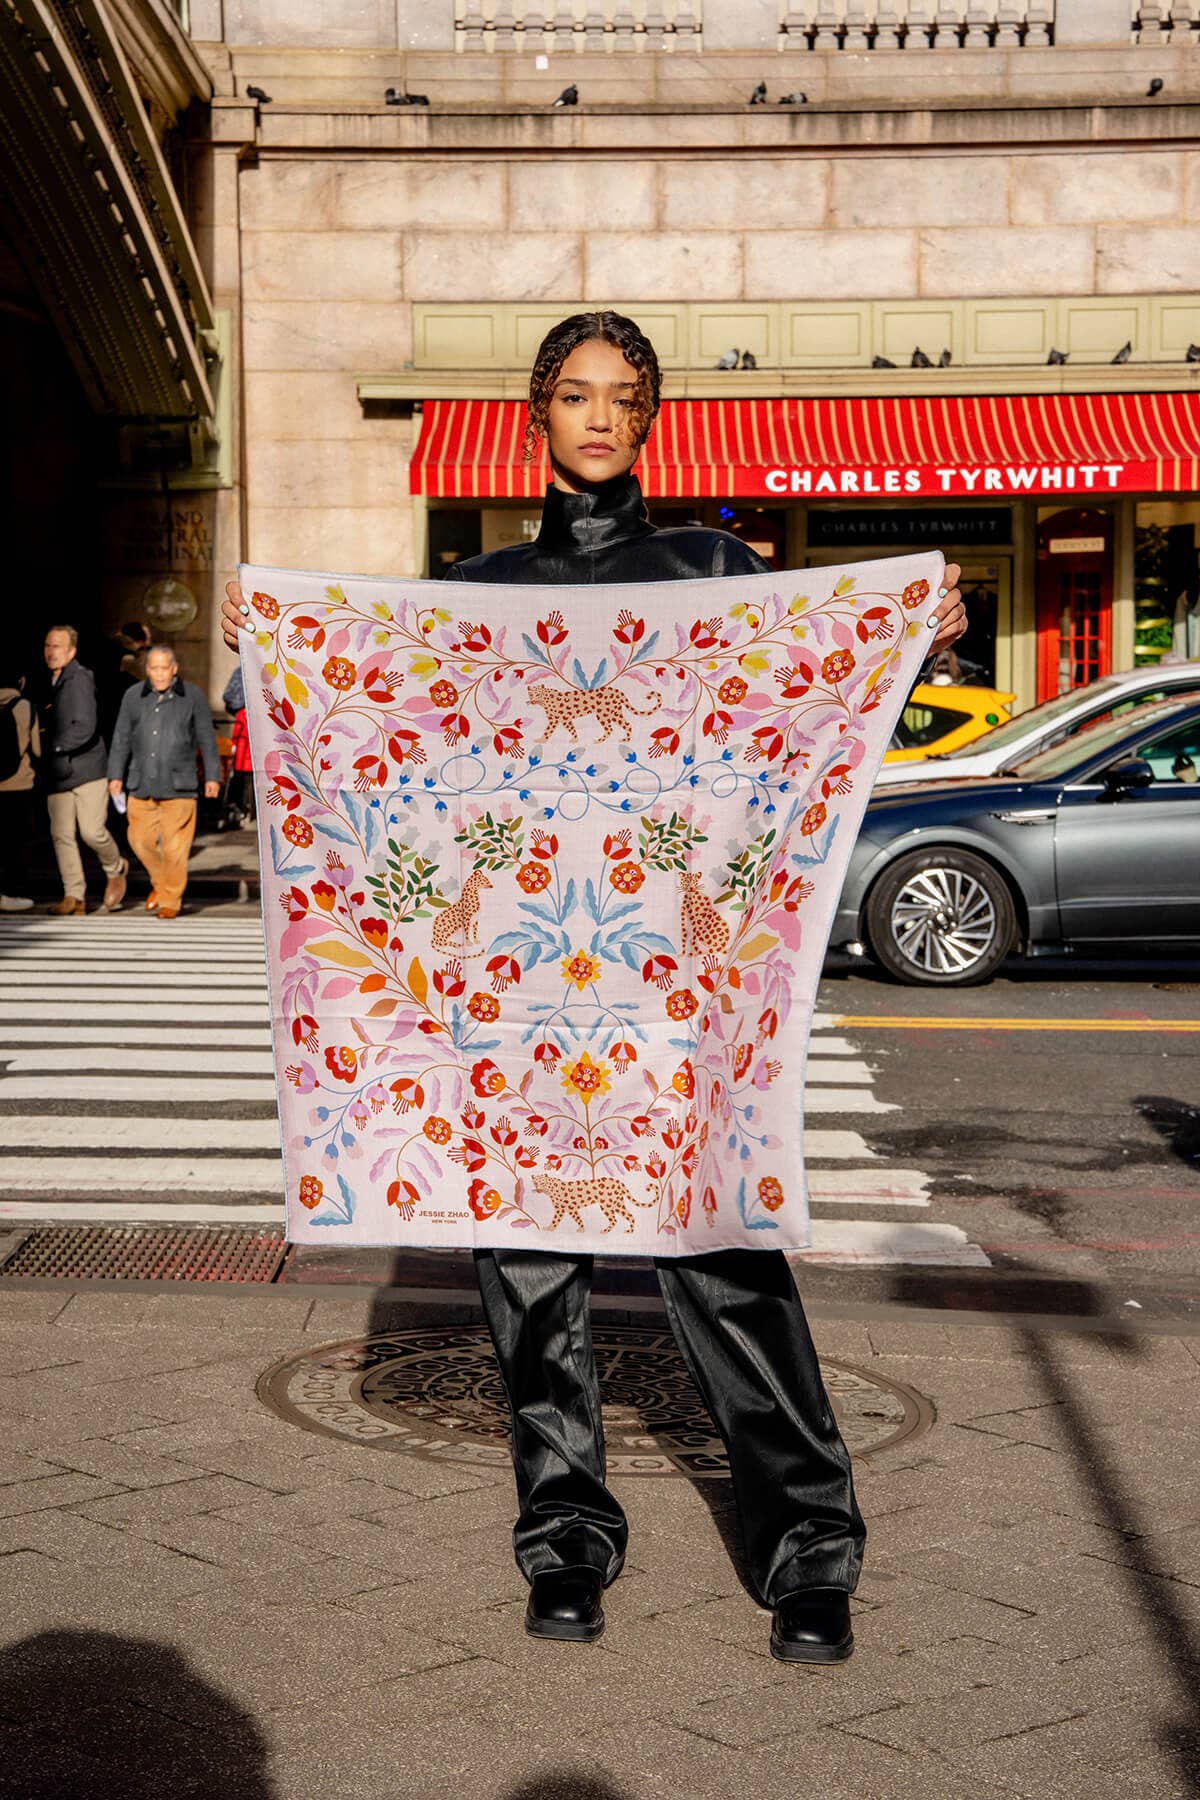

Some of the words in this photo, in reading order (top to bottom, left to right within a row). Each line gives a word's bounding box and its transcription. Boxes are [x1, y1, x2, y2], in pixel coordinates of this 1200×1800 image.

[765, 469, 921, 493] CHARLES
[935, 465, 1124, 491] TYRWHITT
[134, 510, 204, 528] RAND
[821, 520, 899, 533] CHARLES
[907, 520, 997, 532] TYRWHITT
[127, 528, 213, 543] NTRAL
